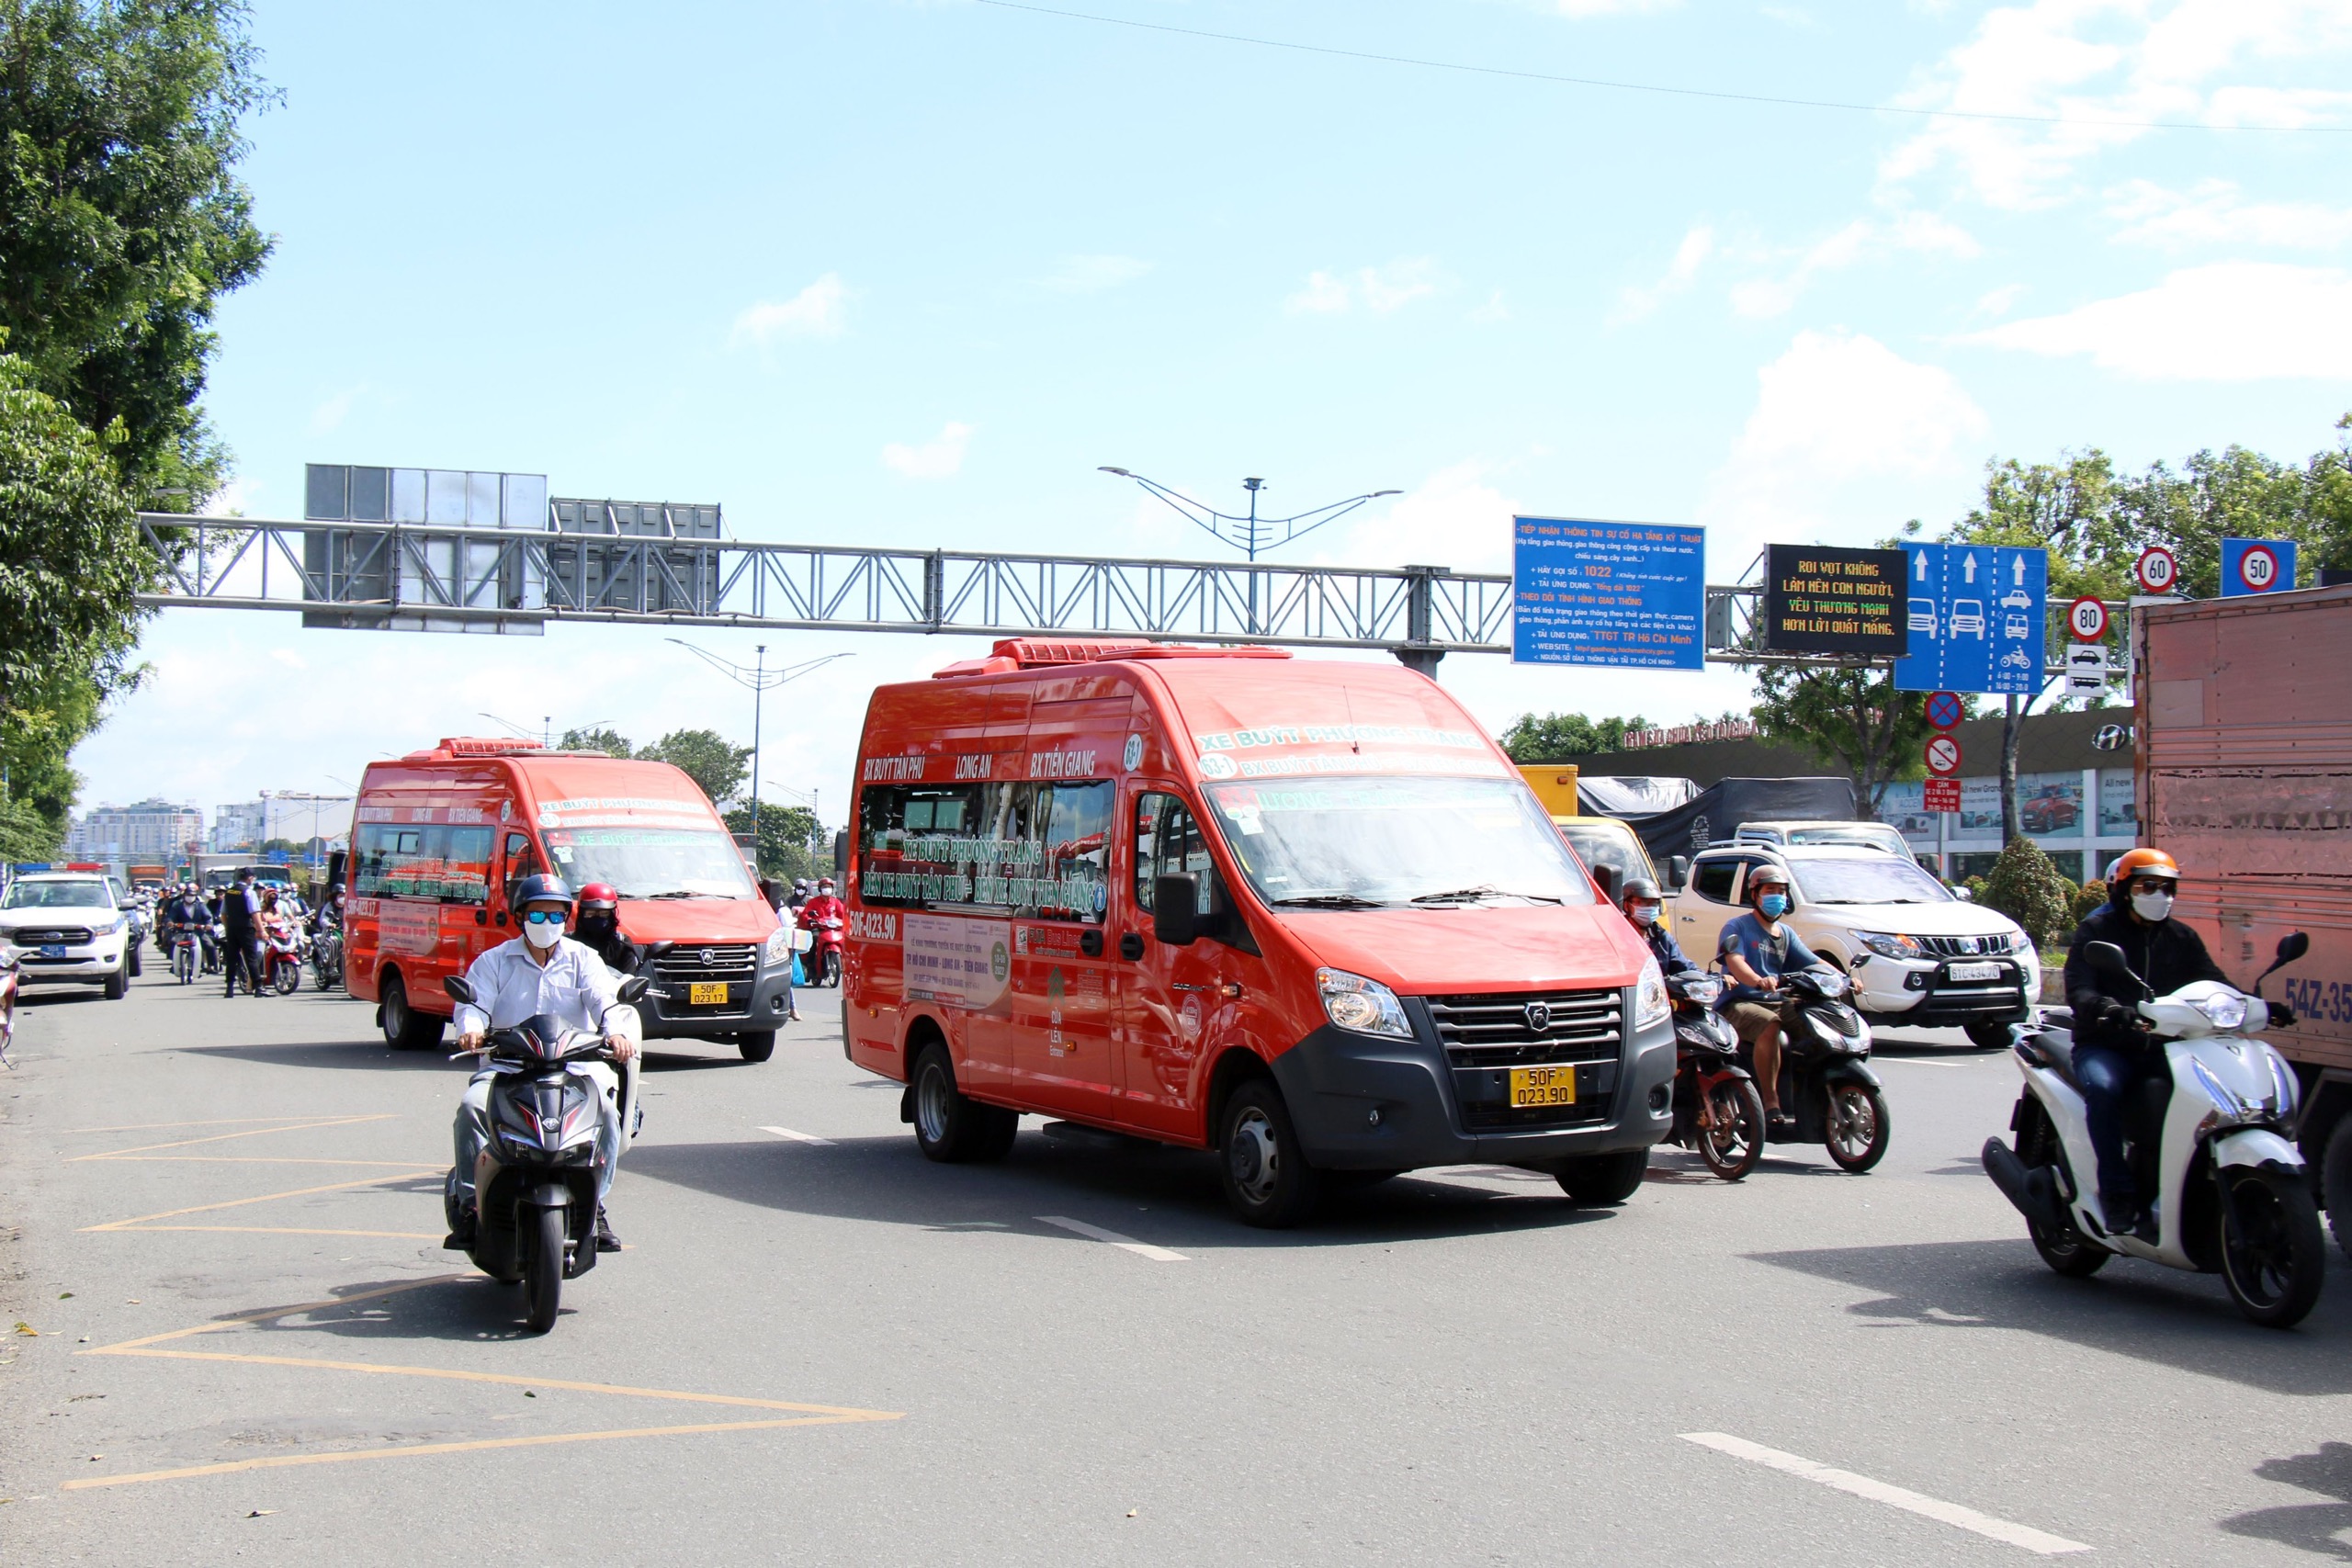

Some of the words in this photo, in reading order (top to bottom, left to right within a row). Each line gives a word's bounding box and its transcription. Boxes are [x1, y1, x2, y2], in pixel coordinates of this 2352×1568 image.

[1564, 526, 1588, 537] THÔNG
[1591, 529, 1603, 537] TIN
[1543, 539, 1555, 547] giao
[1553, 567, 1566, 576] GỌI
[1584, 565, 1611, 578] 1022
[1798, 560, 1817, 573] ROI
[1820, 561, 1842, 577] VỌT
[1845, 560, 1879, 577] KHÔNG
[2149, 560, 2165, 580] 60
[2250, 559, 2267, 579] 50
[1782, 577, 1805, 592] LÀM
[1808, 578, 1829, 593] NÊN
[1832, 582, 1853, 594] CON
[1618, 596, 1642, 606] THÔNG
[1788, 596, 1809, 612] YÊU
[1813, 600, 1858, 614] THƯƠNG
[1860, 603, 1890, 617] MẠNH
[1589, 609, 1608, 618] thông
[2080, 609, 2097, 628] 80
[1782, 618, 1806, 632] HƠN
[1809, 616, 1829, 633] LỜI
[1832, 618, 1860, 634] QUÁT
[1588, 654, 1605, 662] THÔNG
[1199, 735, 1233, 750] XE
[1237, 728, 1298, 747] BUÝT
[1411, 728, 1483, 749] TRANG
[864, 759, 876, 781] BX
[873, 753, 893, 780] BUÝT
[892, 751, 909, 780] TÂN
[907, 750, 925, 780] PHÚ
[955, 755, 978, 779] LONG
[978, 754, 992, 779] AN
[1030, 752, 1045, 778] BX
[1044, 742, 1065, 778] TIỀN
[1066, 750, 1096, 777] GIANG
[1125, 740, 1140, 765] 63-1
[1201, 757, 1234, 775] 63-1
[1241, 761, 1266, 776] BX
[1268, 756, 1309, 774] BUÝT
[1311, 754, 1346, 773] TÂN
[2105, 779, 2114, 787] All
[2115, 779, 2131, 787] new
[541, 802, 559, 811] XE
[562, 799, 598, 809] BUÝT
[902, 839, 918, 862] XE
[918, 833, 949, 863] BUÝT
[949, 834, 998, 863] PHƯƠNG
[1000, 840, 1043, 865] TRANG
[864, 862, 882, 897] BẾN
[882, 872, 895, 897] XE
[895, 866, 921, 899] BUÝT
[922, 866, 942, 900] TÂN
[943, 868, 965, 902] PHÚ
[994, 876, 1009, 905] XE
[1060, 881, 1095, 911] GIANG
[849, 910, 896, 941] 50F-023.90
[695, 994, 724, 1003] 023.17
[701, 985, 717, 994] 50F
[1528, 1068, 1556, 1086] 50F
[1518, 1087, 1568, 1105] 023.90
